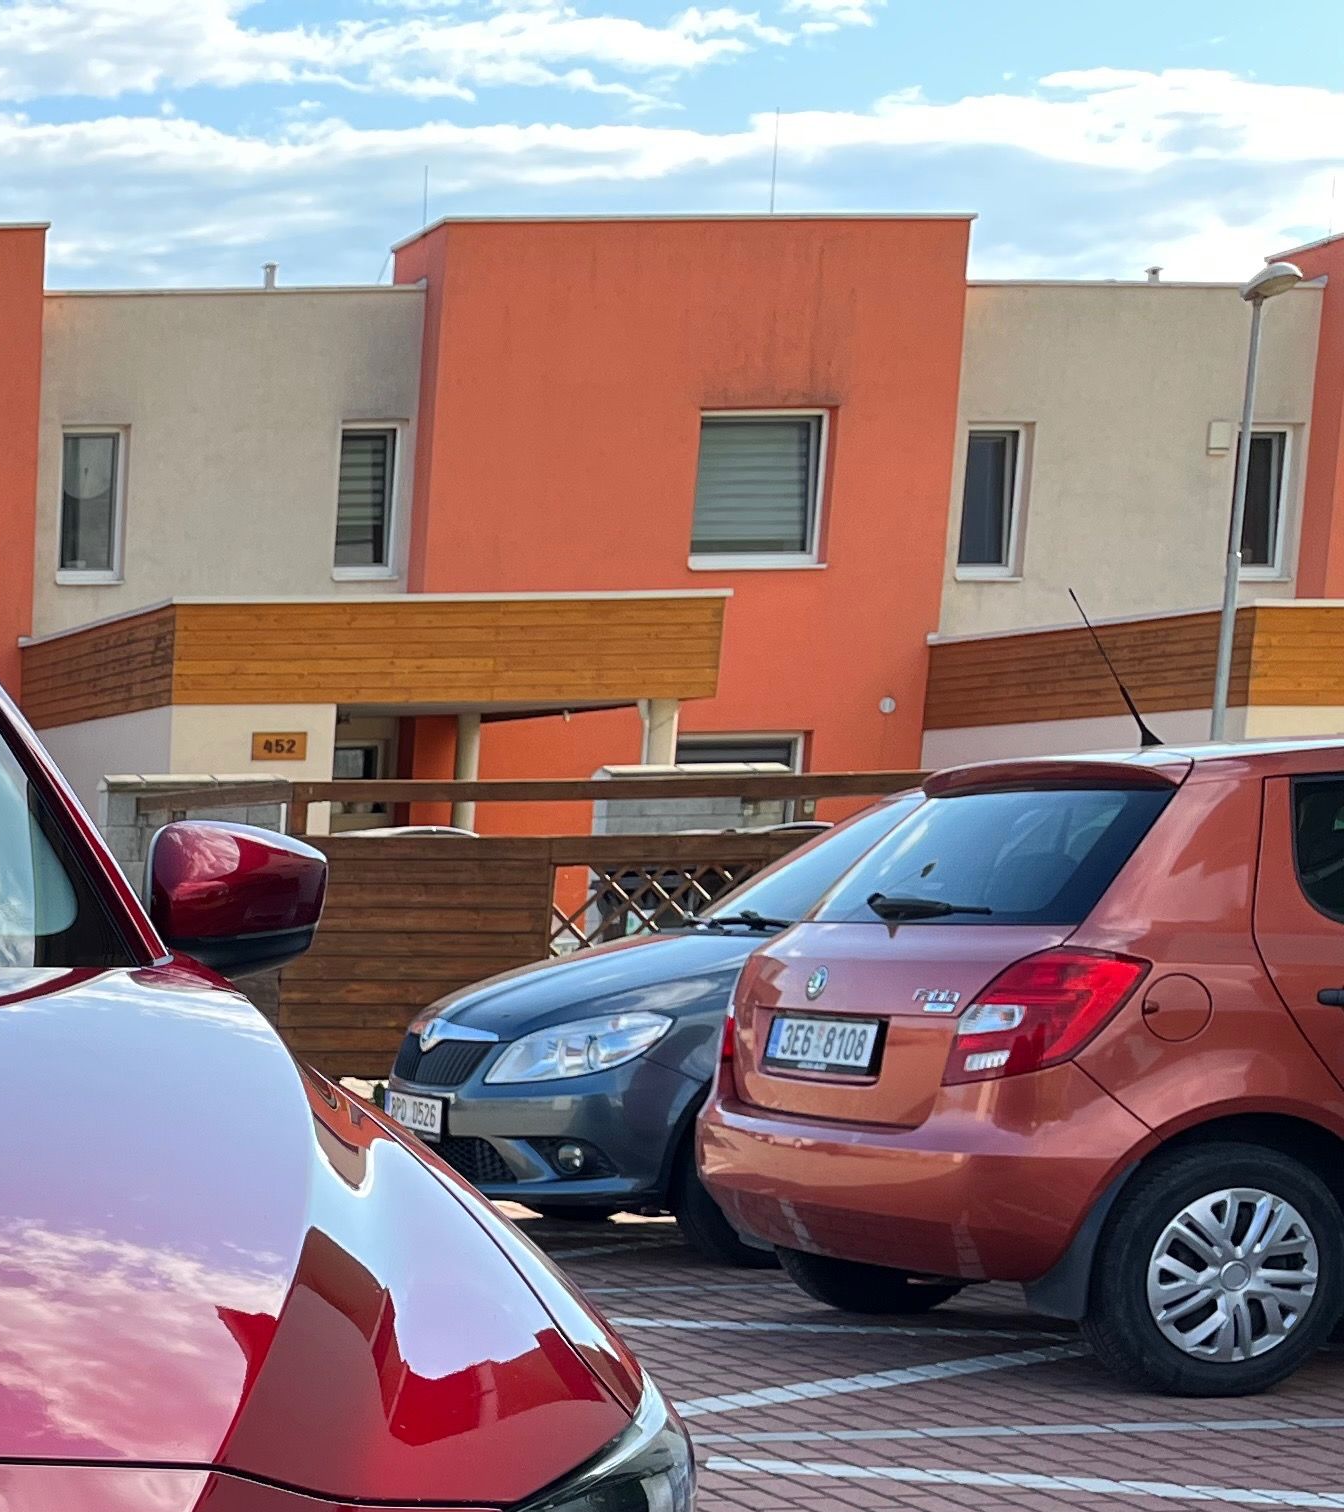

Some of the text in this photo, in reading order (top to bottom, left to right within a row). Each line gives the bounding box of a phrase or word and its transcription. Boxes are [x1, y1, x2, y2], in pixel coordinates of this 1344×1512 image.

[263, 738, 297, 754] 452
[781, 1023, 868, 1062] 3E6 8108
